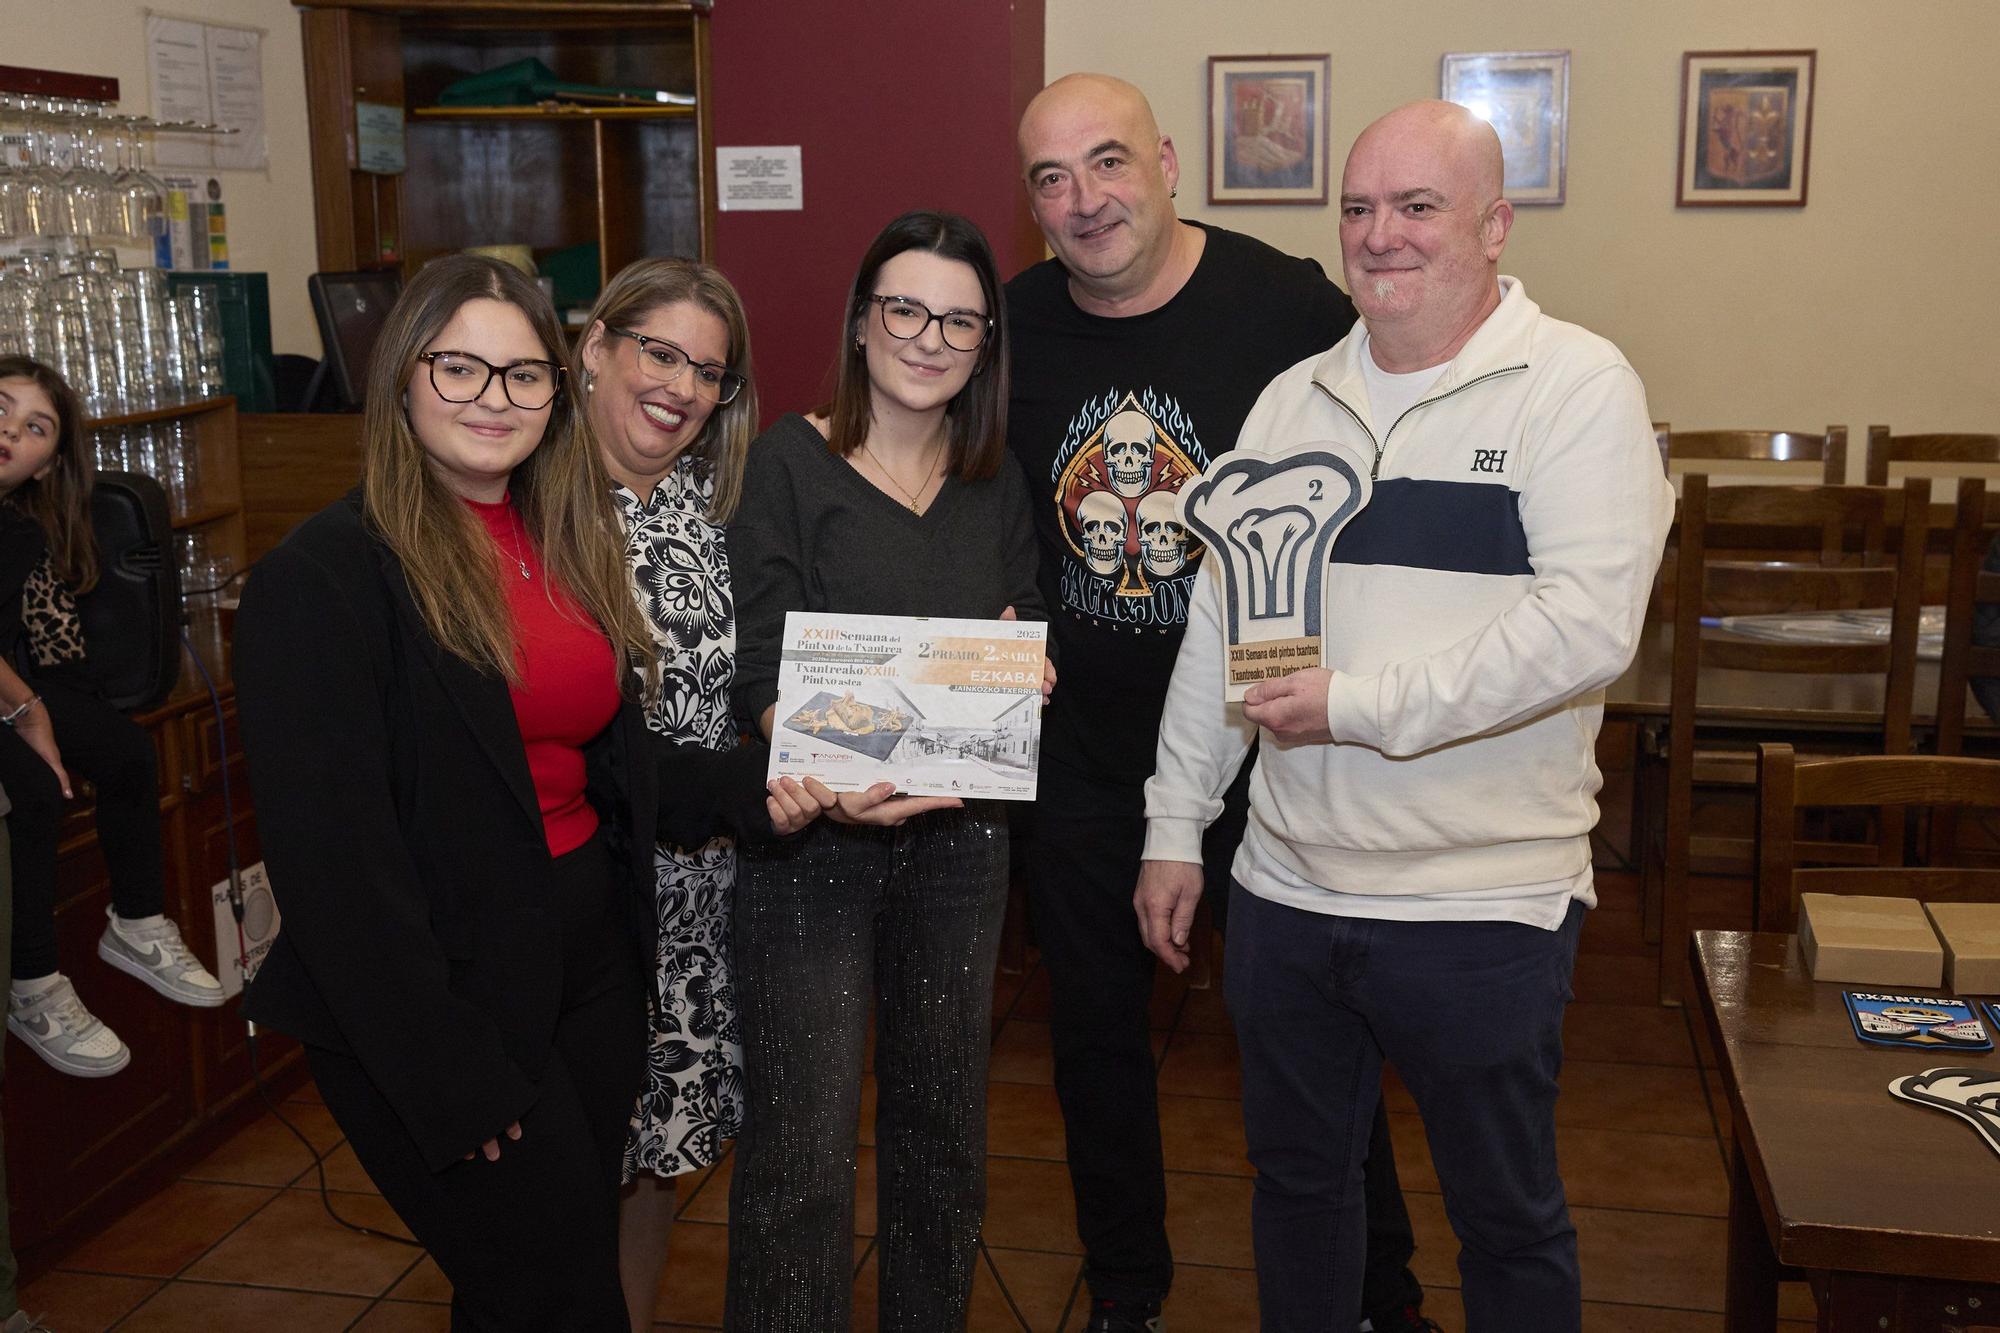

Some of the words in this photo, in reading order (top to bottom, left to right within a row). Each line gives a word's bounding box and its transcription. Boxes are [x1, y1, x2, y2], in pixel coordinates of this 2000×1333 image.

[1470, 449, 1507, 473] RH
[1308, 479, 1324, 501] 2
[840, 630, 887, 642] Semana
[1016, 629, 1041, 639] 2025
[797, 639, 834, 650] Pintxo
[854, 642, 902, 654] Txantrea
[1231, 650, 1244, 662] XXIII
[1245, 648, 1268, 661] Semana
[1269, 646, 1278, 659] del
[1279, 646, 1295, 661] pintxo
[1296, 644, 1319, 657] txantrea
[932, 649, 979, 661] PREMIO
[795, 662, 863, 675] Txantreako
[1232, 667, 1265, 682] Txantreako
[1265, 665, 1281, 679] XXIII
[802, 674, 836, 685] Pintxo
[838, 678, 862, 687] astea
[970, 670, 1037, 684] EZKABA
[953, 685, 1000, 694] JAINKOZKO
[1002, 687, 1038, 696] TXERRIA
[1852, 993, 1966, 1008] TXANTREA
